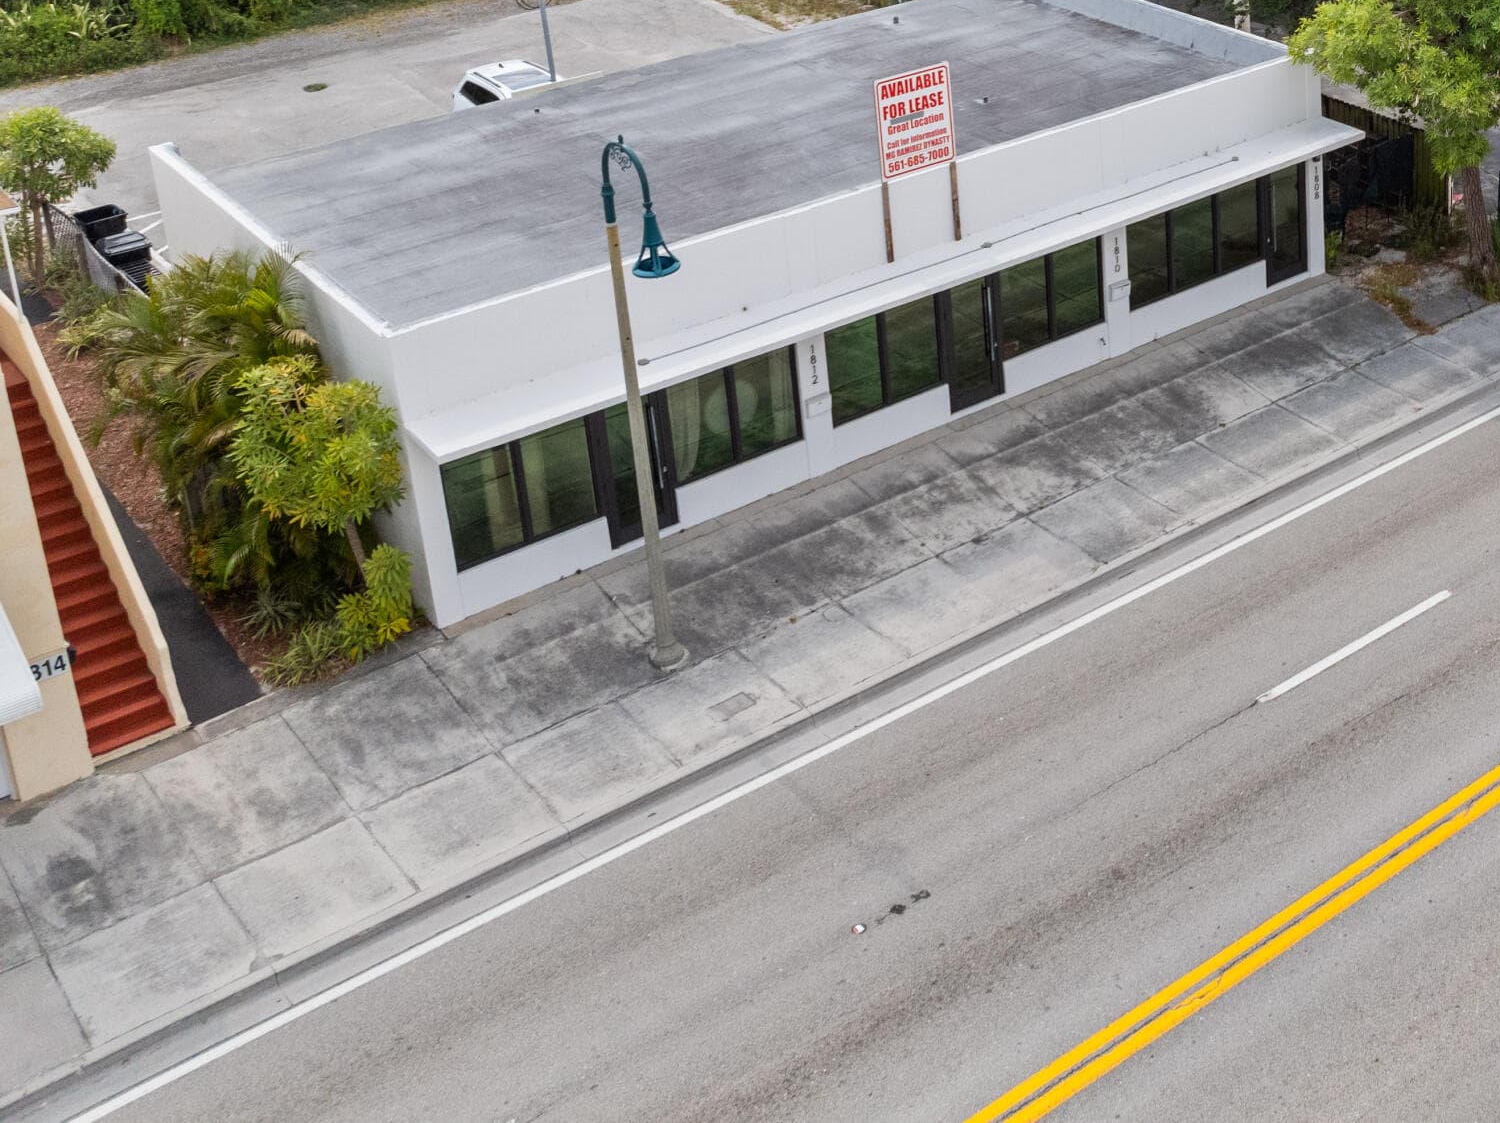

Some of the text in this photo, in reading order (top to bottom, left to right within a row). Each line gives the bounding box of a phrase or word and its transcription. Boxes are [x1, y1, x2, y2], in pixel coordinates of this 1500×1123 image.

[881, 70, 945, 100] AVAILABLE
[883, 91, 944, 121] FOR LEASE
[887, 112, 944, 136] Great Location
[887, 139, 900, 150] Call
[923, 135, 950, 150] DYNASTY
[888, 146, 950, 173] 561-685-7000
[810, 344, 819, 385] 1812
